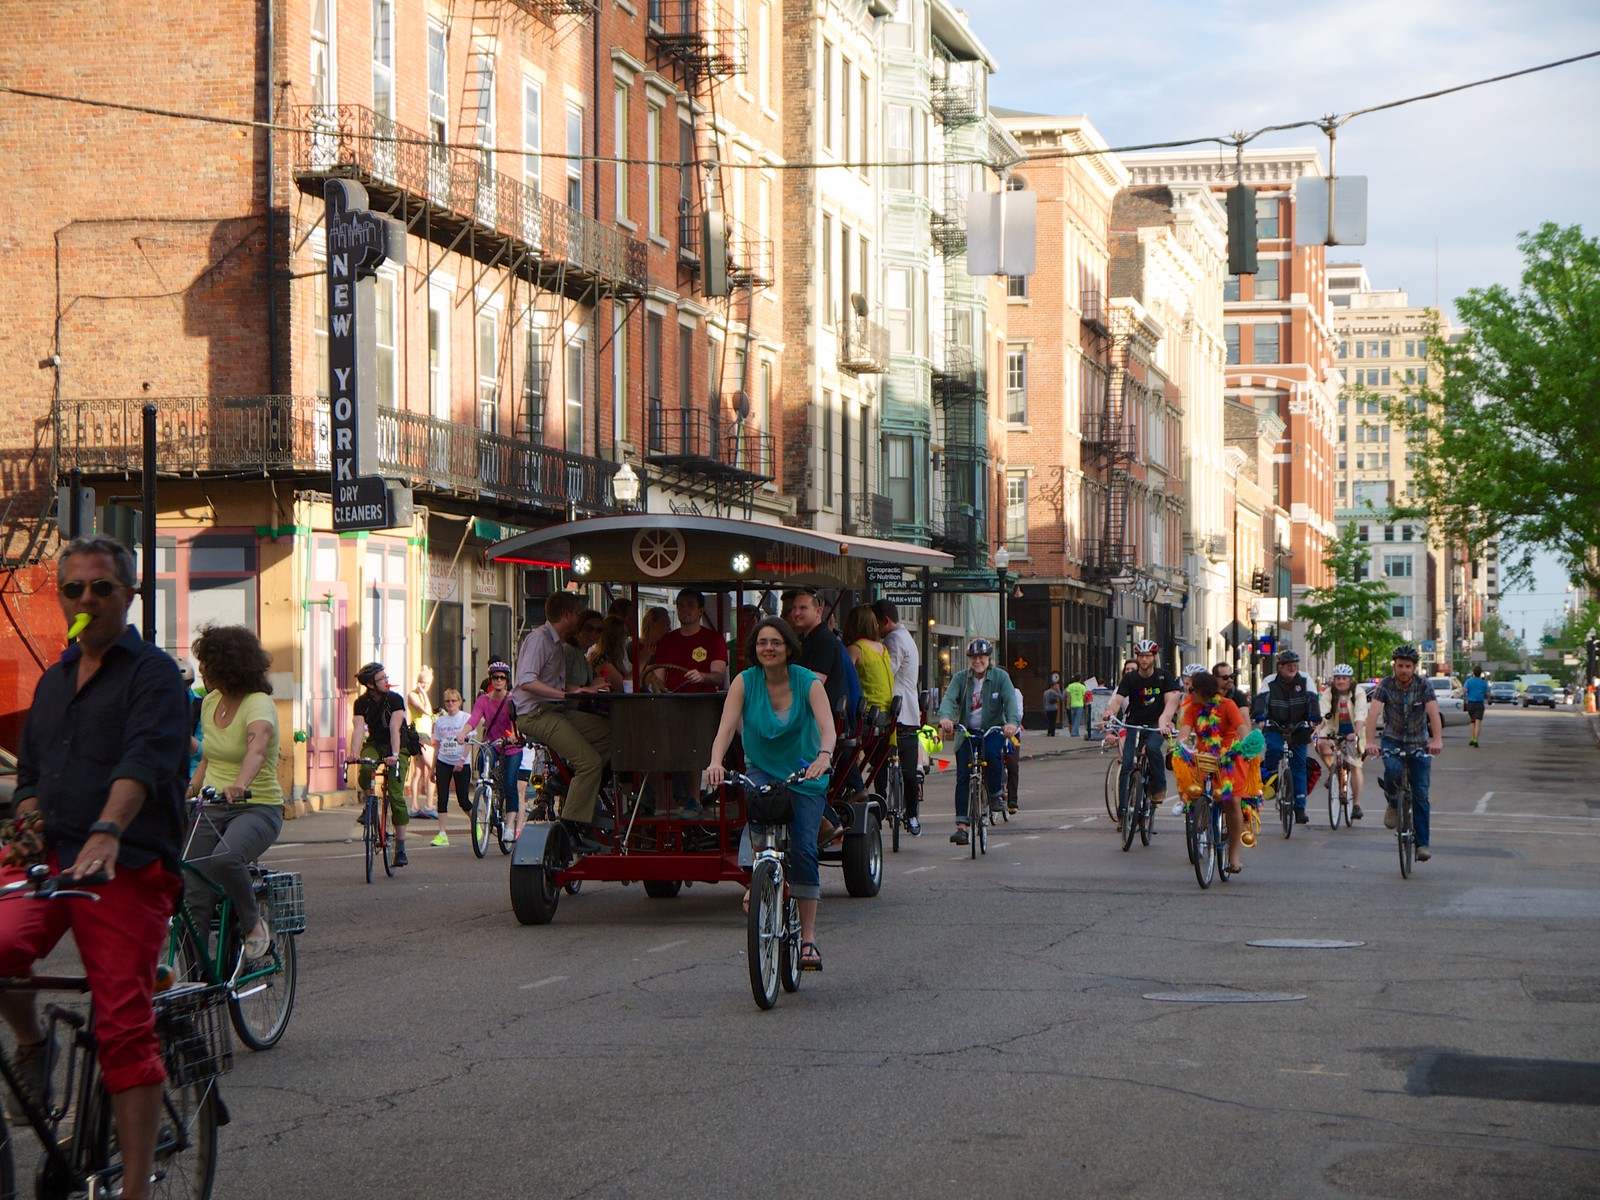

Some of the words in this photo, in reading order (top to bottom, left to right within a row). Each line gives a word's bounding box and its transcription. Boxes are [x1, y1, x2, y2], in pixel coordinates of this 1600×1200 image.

[331, 253, 352, 338] NEW
[333, 367, 352, 481] YORK
[340, 485, 359, 502] DRY
[334, 504, 383, 523] CLEANERS
[783, 542, 815, 579] PEDAL
[815, 549, 848, 585] WAGON
[866, 566, 900, 574] Chiropractic
